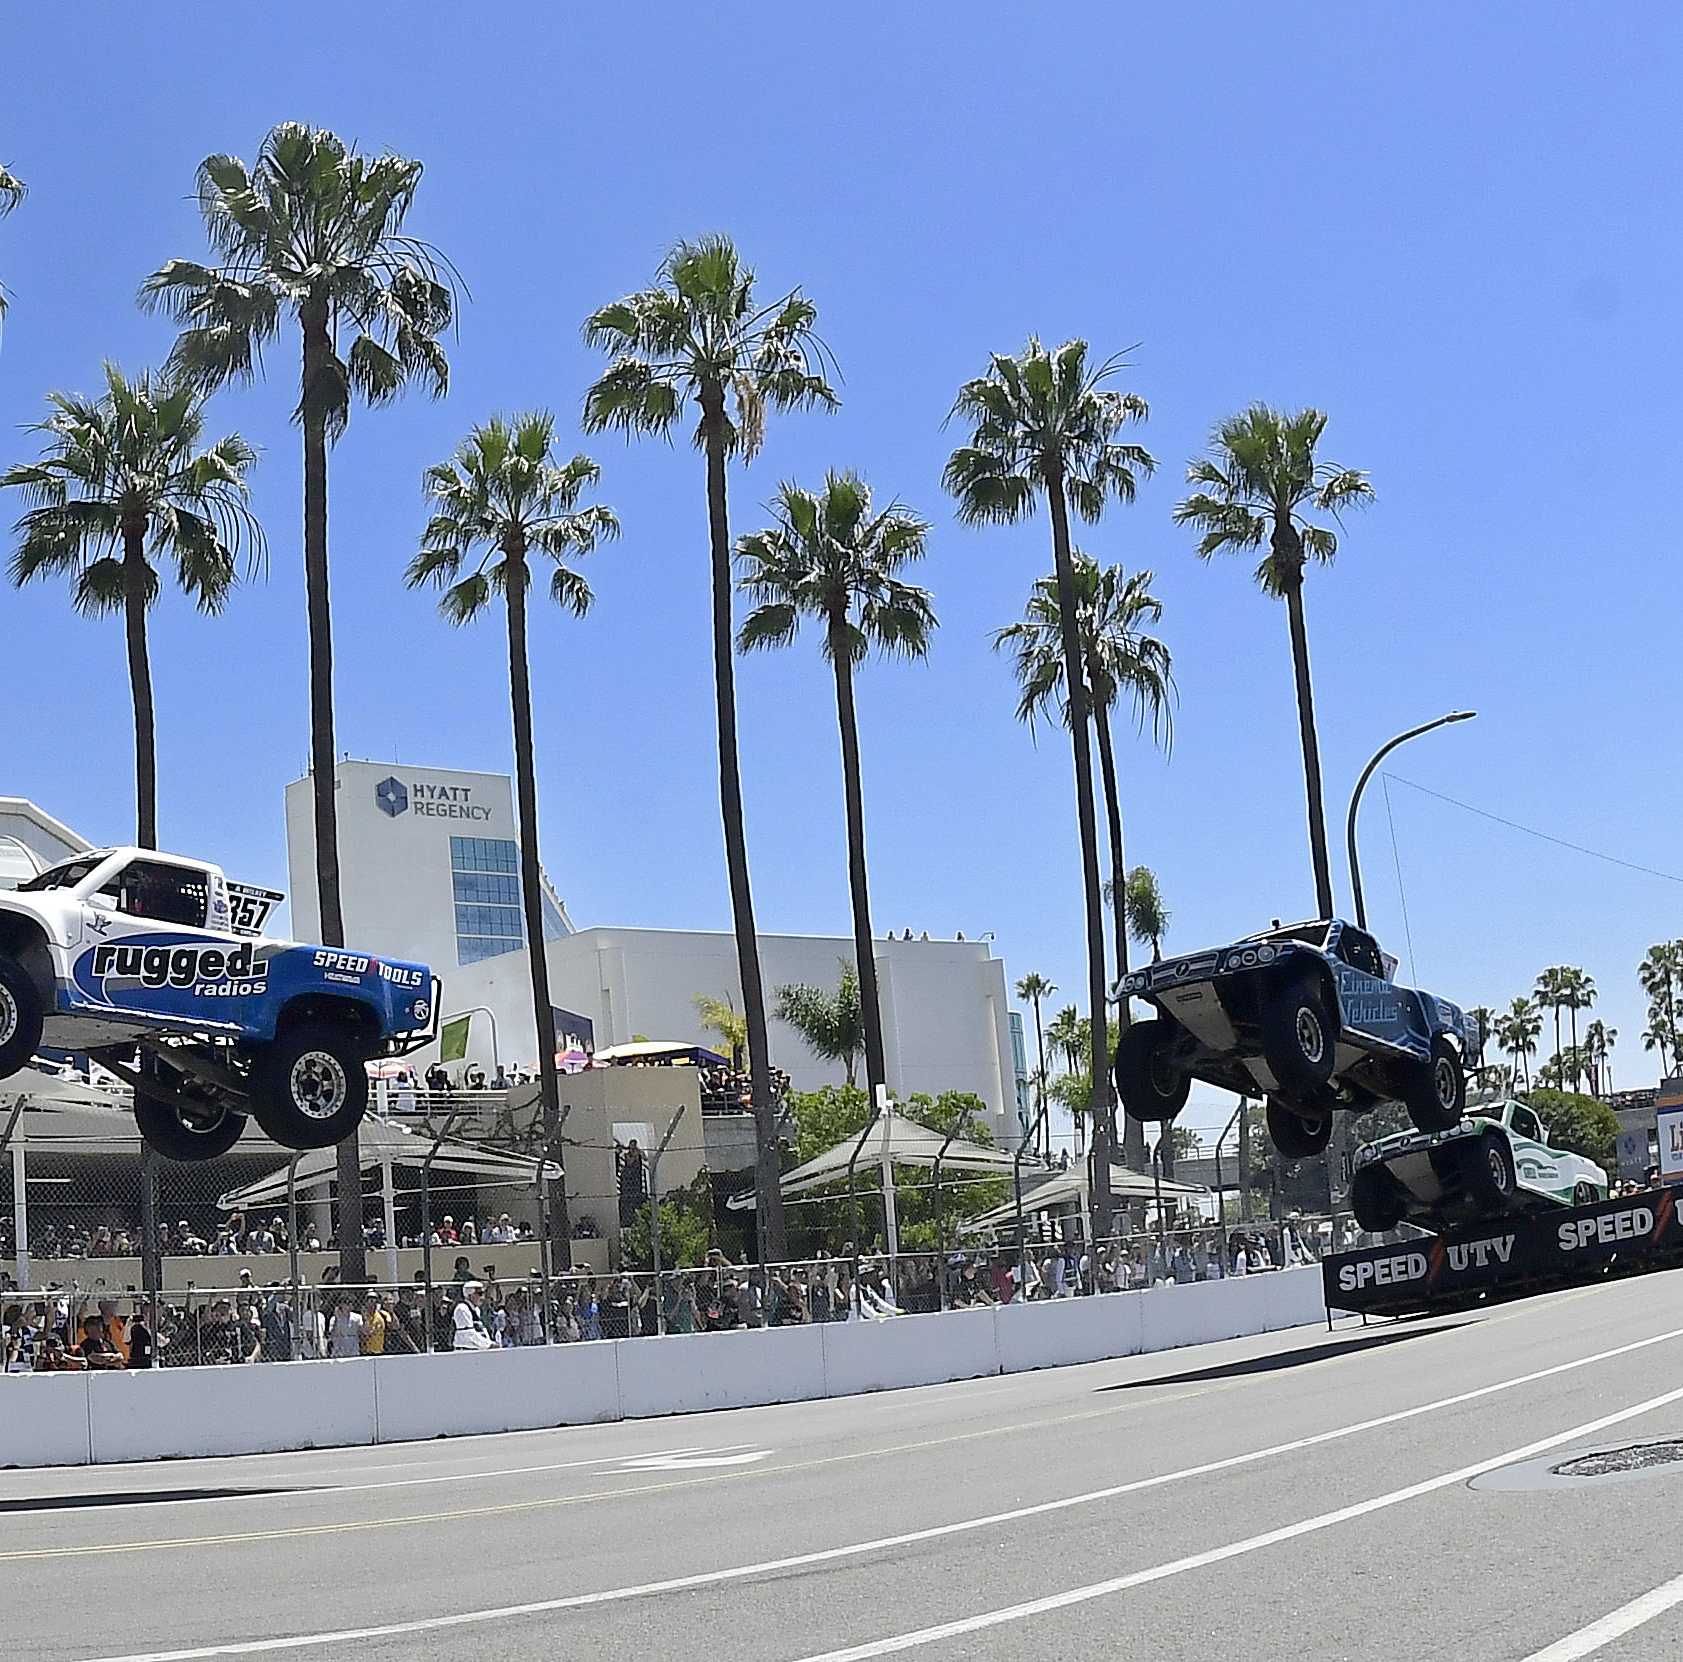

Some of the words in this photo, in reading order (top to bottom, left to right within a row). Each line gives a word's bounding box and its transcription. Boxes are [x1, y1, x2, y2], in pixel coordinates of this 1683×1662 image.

[413, 784, 471, 802] HYATT
[414, 801, 492, 820] REGENCY
[229, 894, 271, 929] 357
[313, 951, 369, 973] SPEED
[378, 961, 423, 986] TOOLS
[194, 980, 267, 997] radios
[1558, 1207, 1654, 1250] SPEED
[1339, 1252, 1428, 1291] SPEED
[1447, 1234, 1516, 1271] UTV
